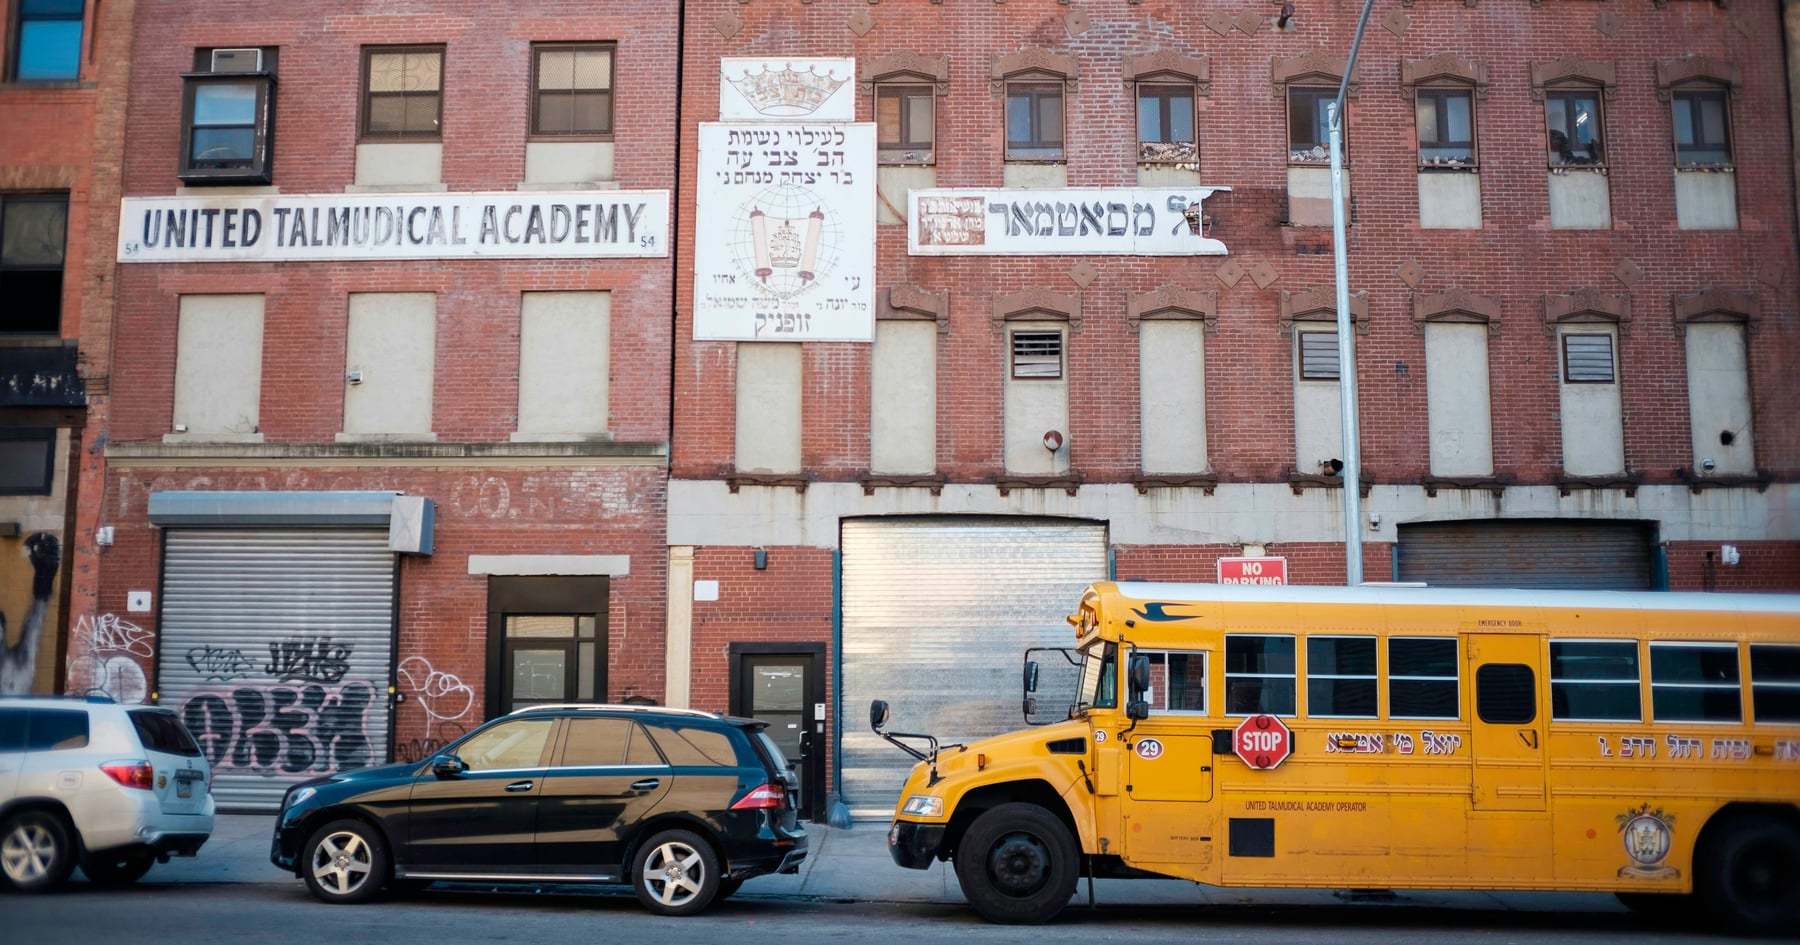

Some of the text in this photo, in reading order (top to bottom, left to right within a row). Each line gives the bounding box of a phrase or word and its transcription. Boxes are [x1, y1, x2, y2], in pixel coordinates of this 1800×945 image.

[727, 126, 845, 146] לעילוי נשמת
[762, 150, 798, 166] צבי
[779, 171, 822, 188] יצחק
[143, 203, 647, 248] UNITED TALMUDICAL ACADEMY
[125, 243, 139, 255] 54
[1242, 562, 1263, 576] NO
[1223, 576, 1282, 586] PARKING
[1095, 731, 1105, 742] 29
[1242, 731, 1282, 752] STOP
[1421, 730, 1462, 755] יואל
[1141, 741, 1159, 756] 29
[1666, 734, 1704, 760] רחל
[1245, 800, 1367, 813] UNITED TALMUDICAL ACADEMY OPERATOR
